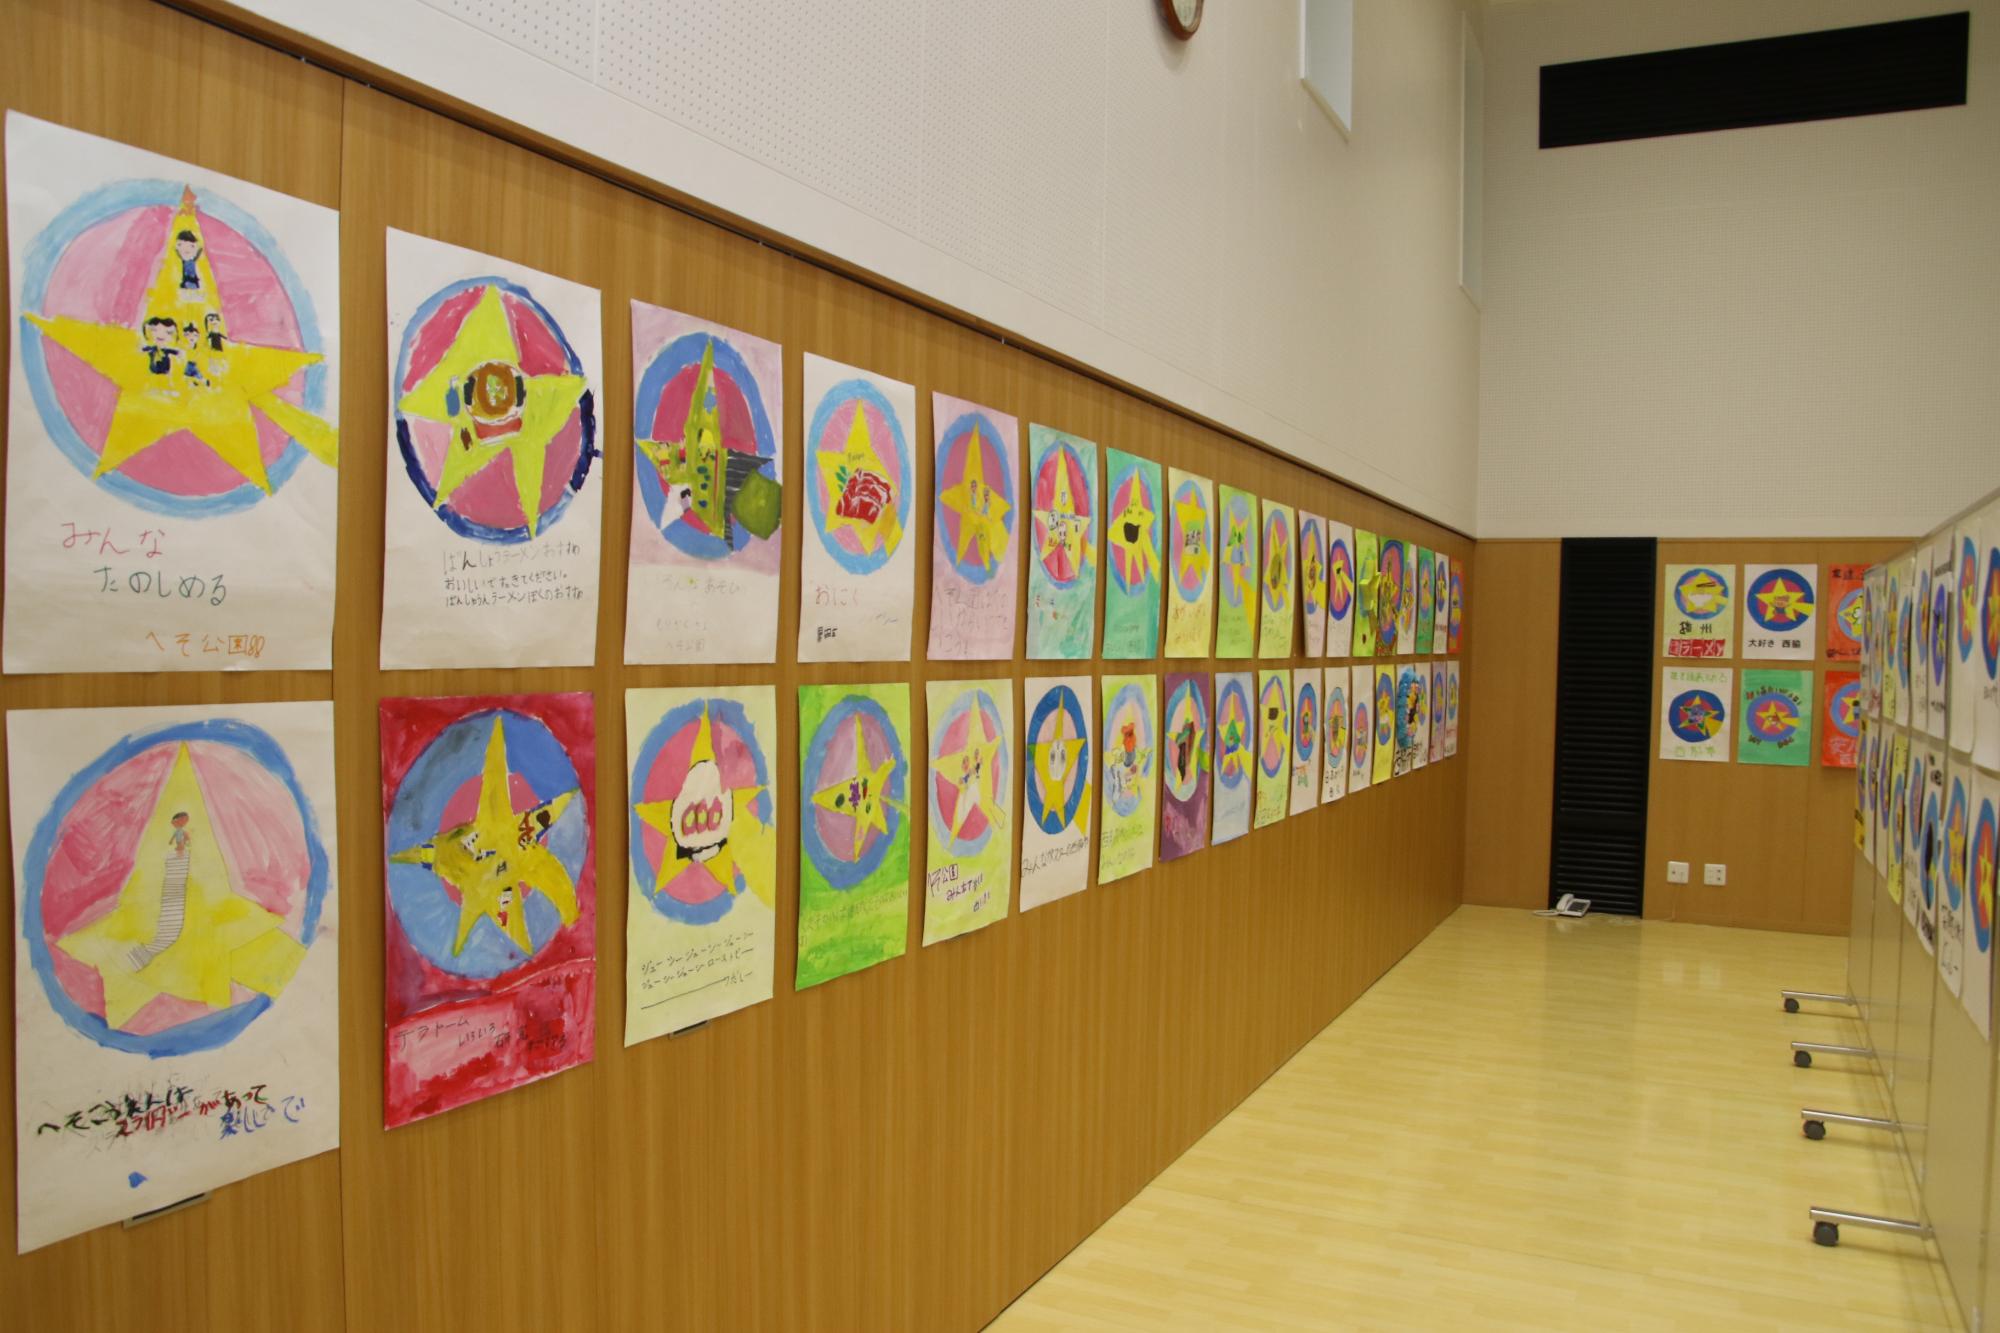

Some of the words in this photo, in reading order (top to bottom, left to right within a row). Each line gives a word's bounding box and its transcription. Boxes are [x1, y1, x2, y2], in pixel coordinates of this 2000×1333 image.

[61, 522, 165, 558] みんな
[93, 566, 227, 606] たのしめる
[1748, 639, 1775, 648] 大好き
